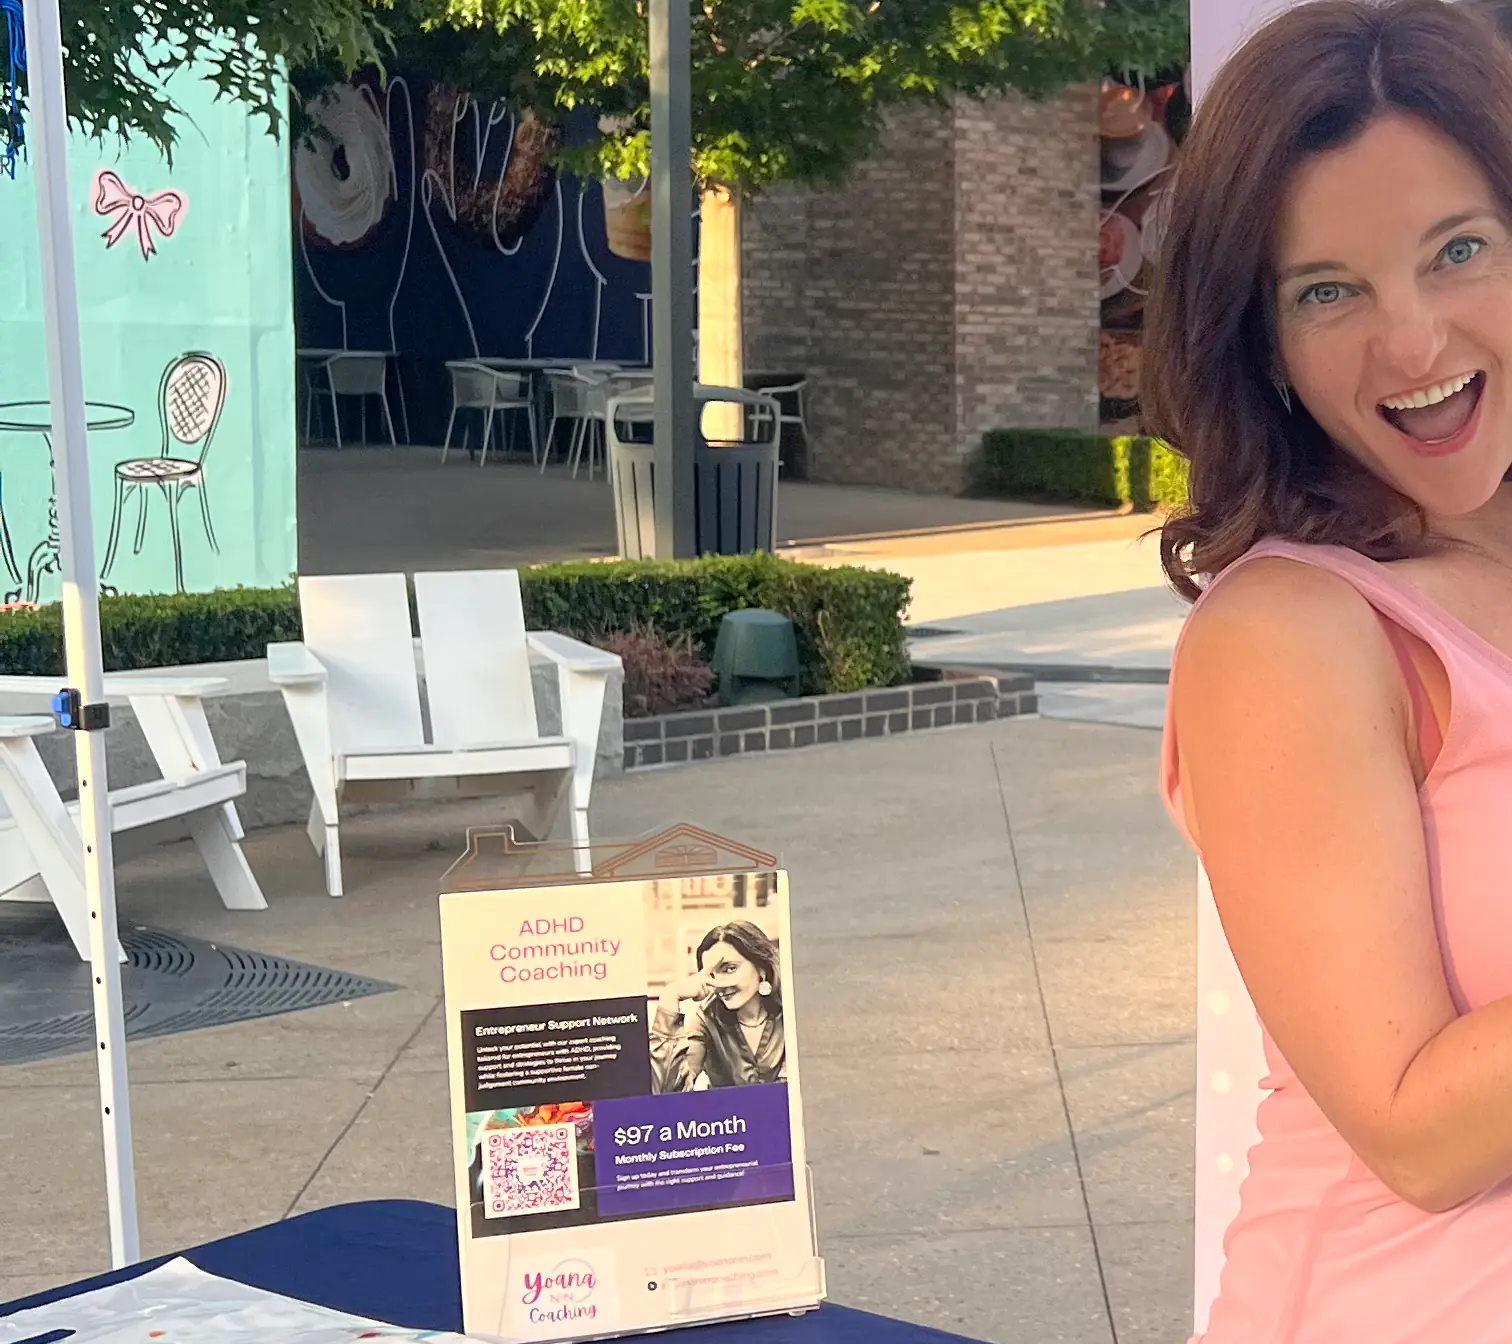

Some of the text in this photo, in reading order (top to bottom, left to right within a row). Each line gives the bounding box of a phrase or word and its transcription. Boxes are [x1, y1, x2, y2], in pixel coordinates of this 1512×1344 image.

[519, 916, 585, 937] ADHD
[490, 937, 621, 961] Community
[500, 961, 607, 983] Coaching
[475, 1013, 638, 1037] Entrepreneur Support Network
[614, 1115, 747, 1147] $97 a Month
[615, 1142, 745, 1165] Monthly Subscription Fee
[522, 1271, 597, 1305] Yoana
[529, 1304, 597, 1324] Coaching
